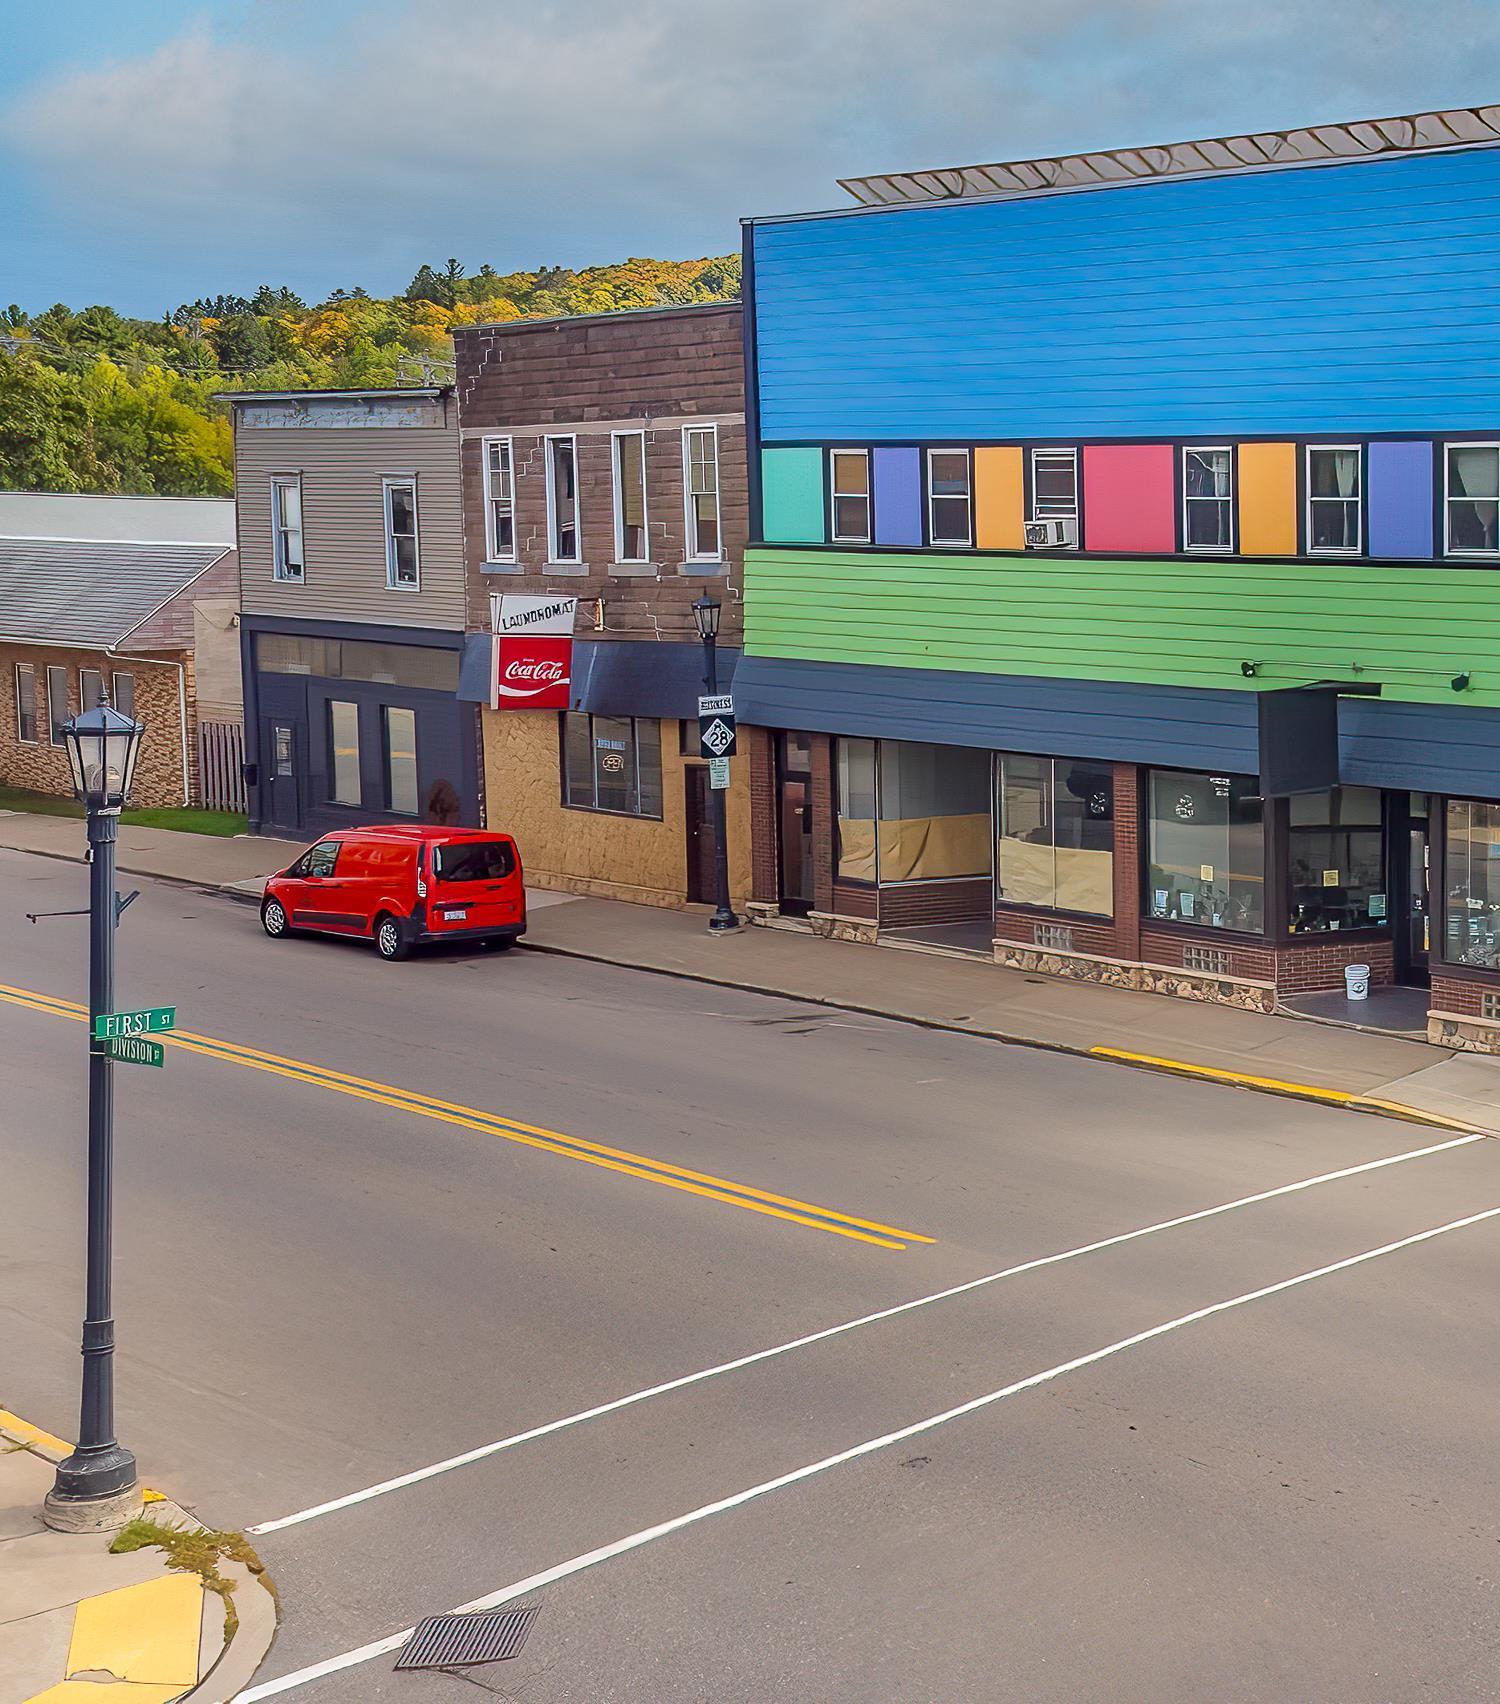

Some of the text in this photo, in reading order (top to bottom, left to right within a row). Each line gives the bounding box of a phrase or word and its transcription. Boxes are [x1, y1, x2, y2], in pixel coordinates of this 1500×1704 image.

[502, 600, 574, 630] LAUNDROMAT
[710, 731, 728, 748] 28
[106, 1012, 171, 1036] FIRST ST
[112, 1037, 153, 1062] DIVISION
